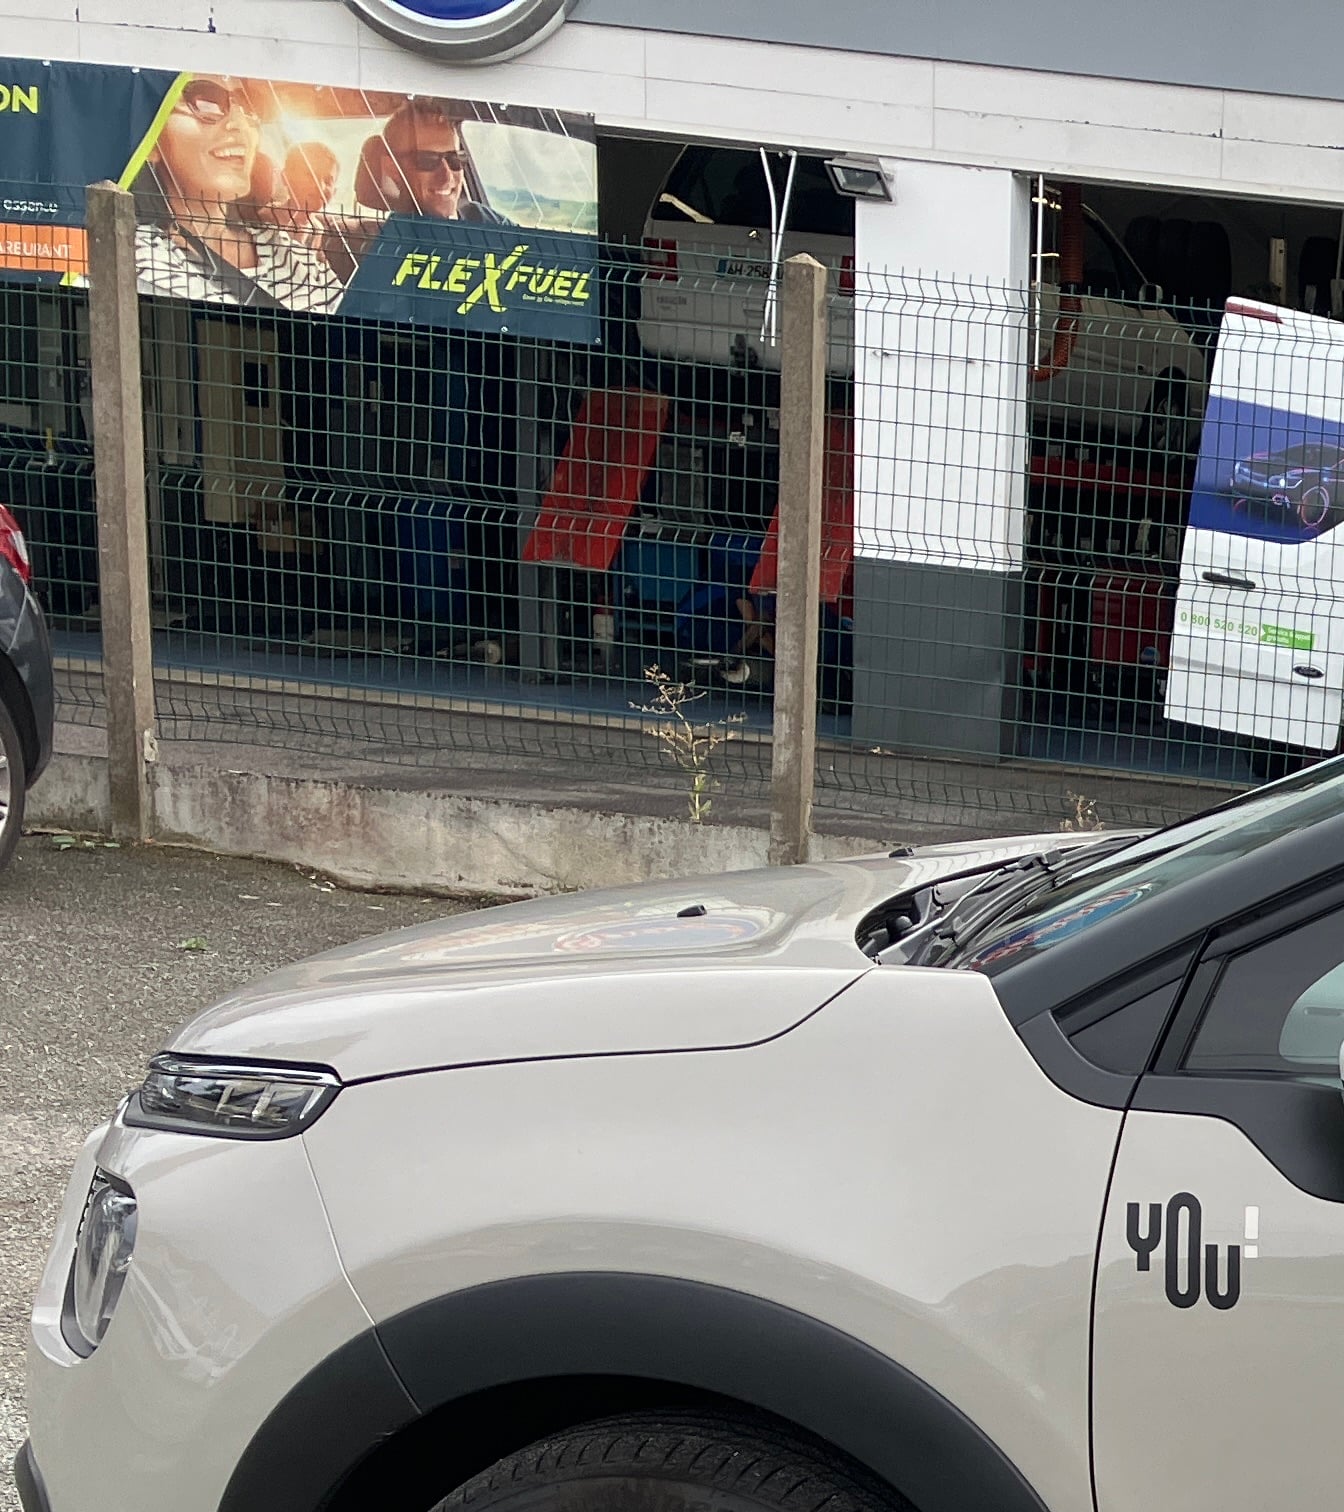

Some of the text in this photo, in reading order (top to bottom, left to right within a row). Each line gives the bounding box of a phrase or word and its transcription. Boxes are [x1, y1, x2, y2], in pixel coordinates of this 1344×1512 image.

[1180, 611, 1188, 622] 0
[1213, 618, 1234, 632] 520
[1237, 623, 1258, 637] 520
